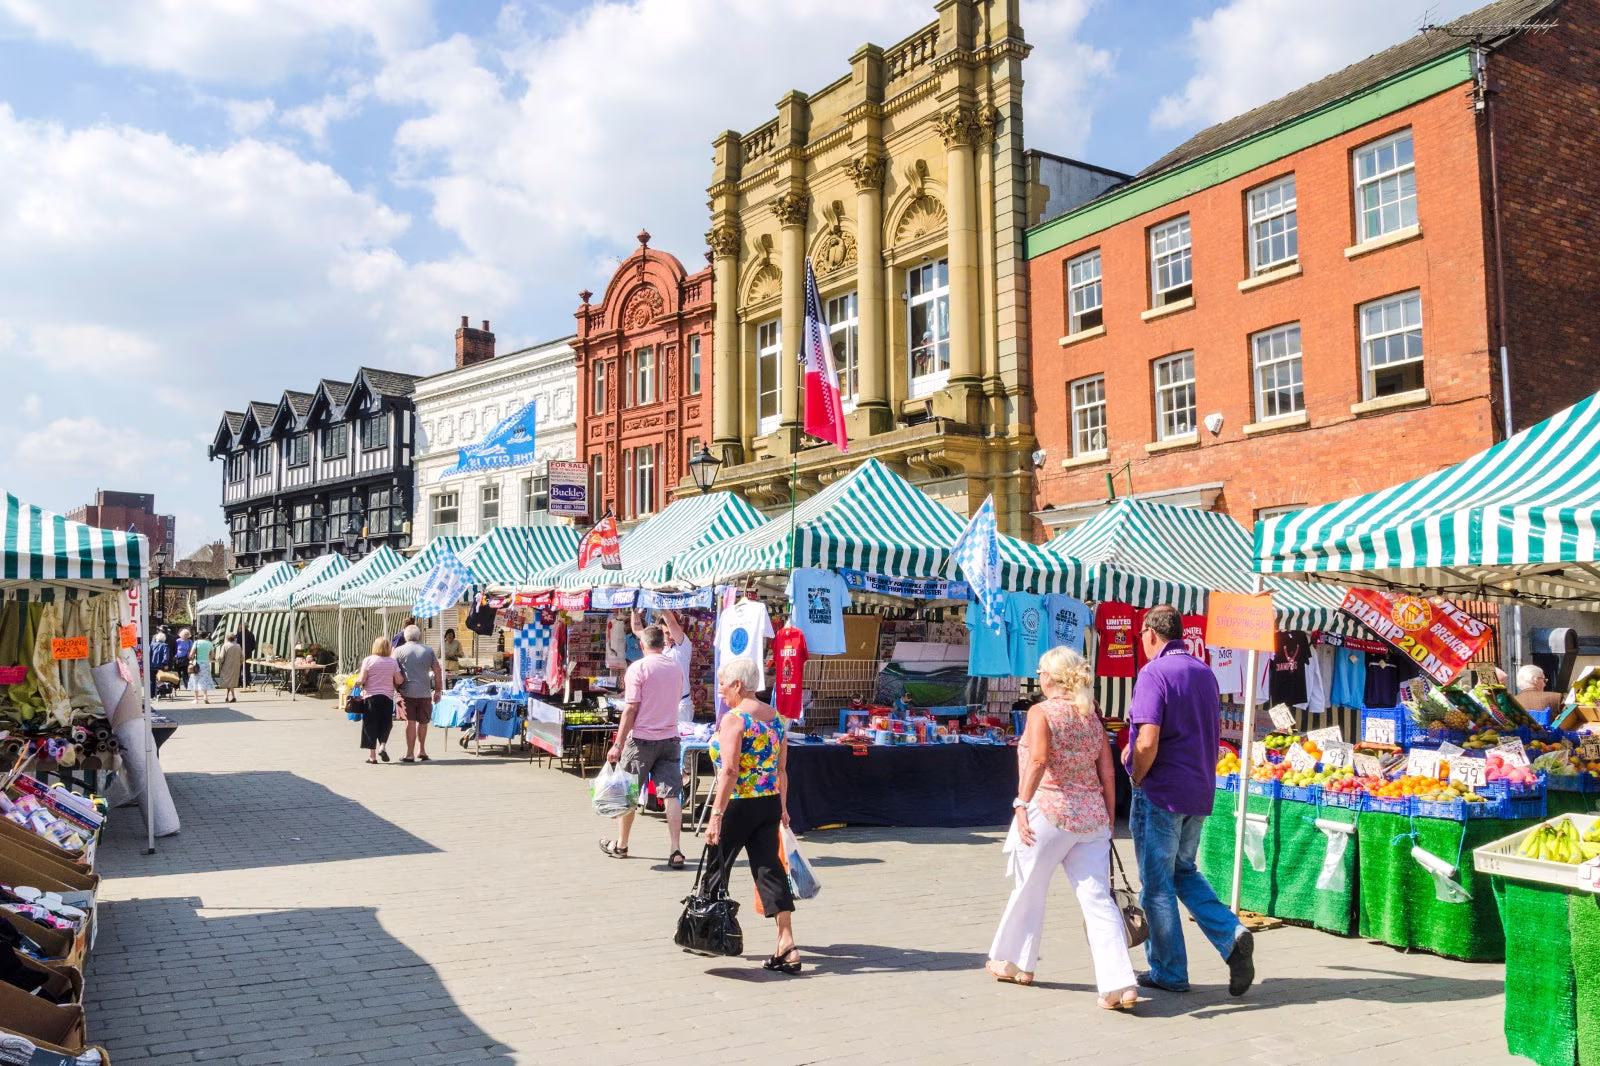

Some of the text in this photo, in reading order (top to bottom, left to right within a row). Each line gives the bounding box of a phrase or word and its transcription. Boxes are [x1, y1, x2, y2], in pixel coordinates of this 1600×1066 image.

[552, 487, 585, 498] Buckley
[866, 575, 878, 583] THE
[877, 578, 893, 586] ONLY
[893, 581, 923, 589] FOOTBALL
[871, 583, 942, 596] COME FROM MANCHESTER
[1060, 609, 1077, 618] CITY
[1215, 616, 1255, 628] SHOPPING
[1429, 622, 1473, 661] BREAKERS
[496, 701, 516, 712] CITY
[1328, 750, 1346, 767] 99
[1459, 767, 1479, 784] 99
